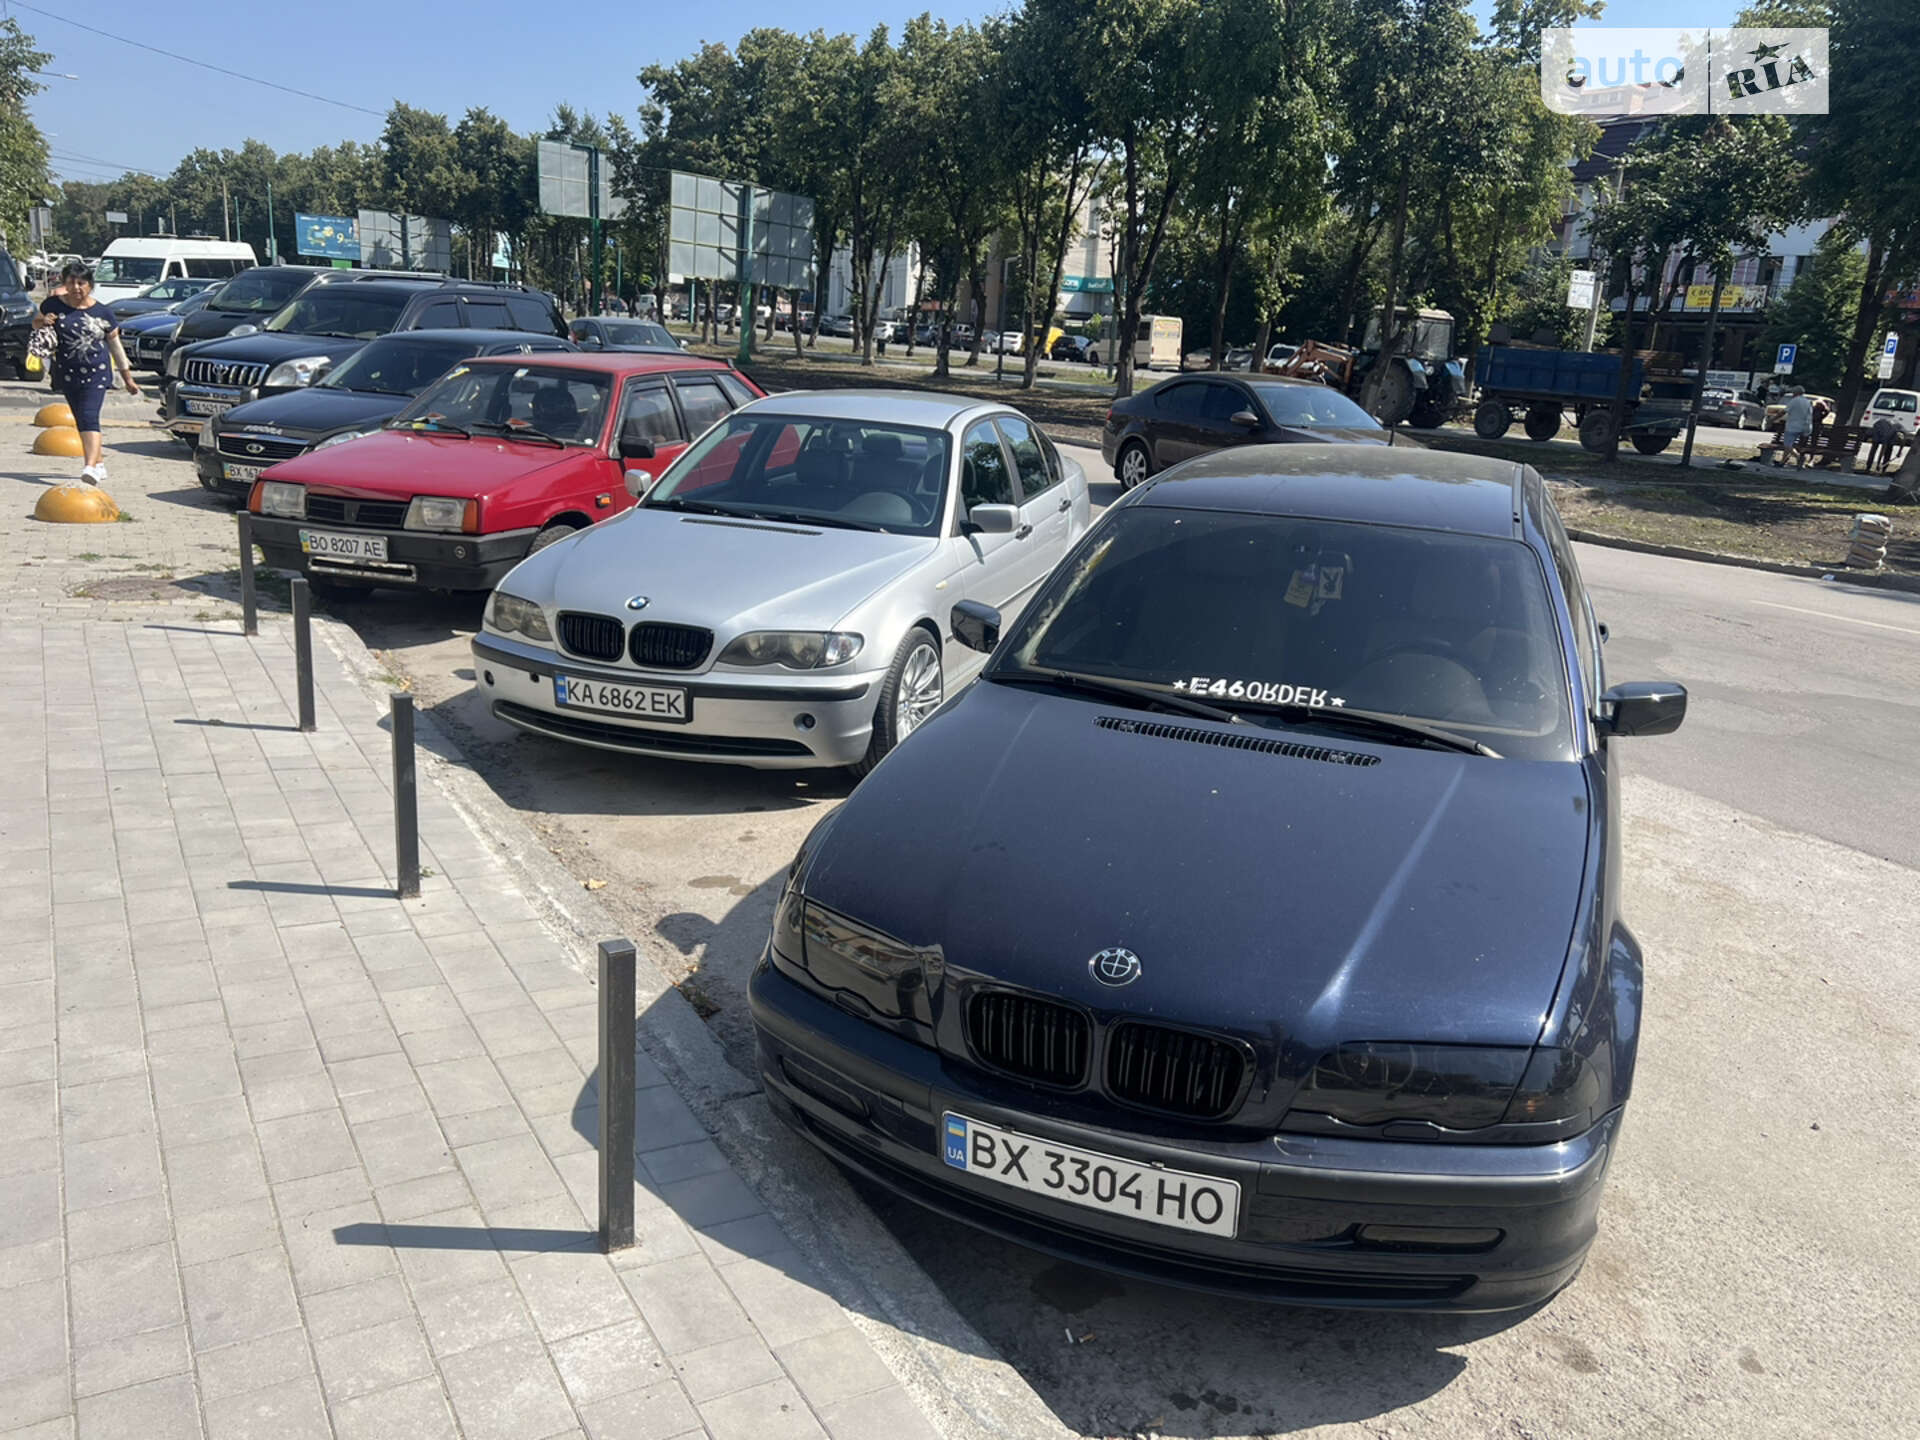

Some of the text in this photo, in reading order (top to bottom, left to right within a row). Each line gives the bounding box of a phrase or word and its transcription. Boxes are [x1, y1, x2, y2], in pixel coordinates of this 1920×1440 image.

[309, 535, 382, 557] BO 8207 AE
[567, 680, 594, 705] KA
[599, 686, 647, 711] 6862
[651, 692, 682, 715] EK
[948, 1129, 1224, 1225] UA BX 3304 HO
